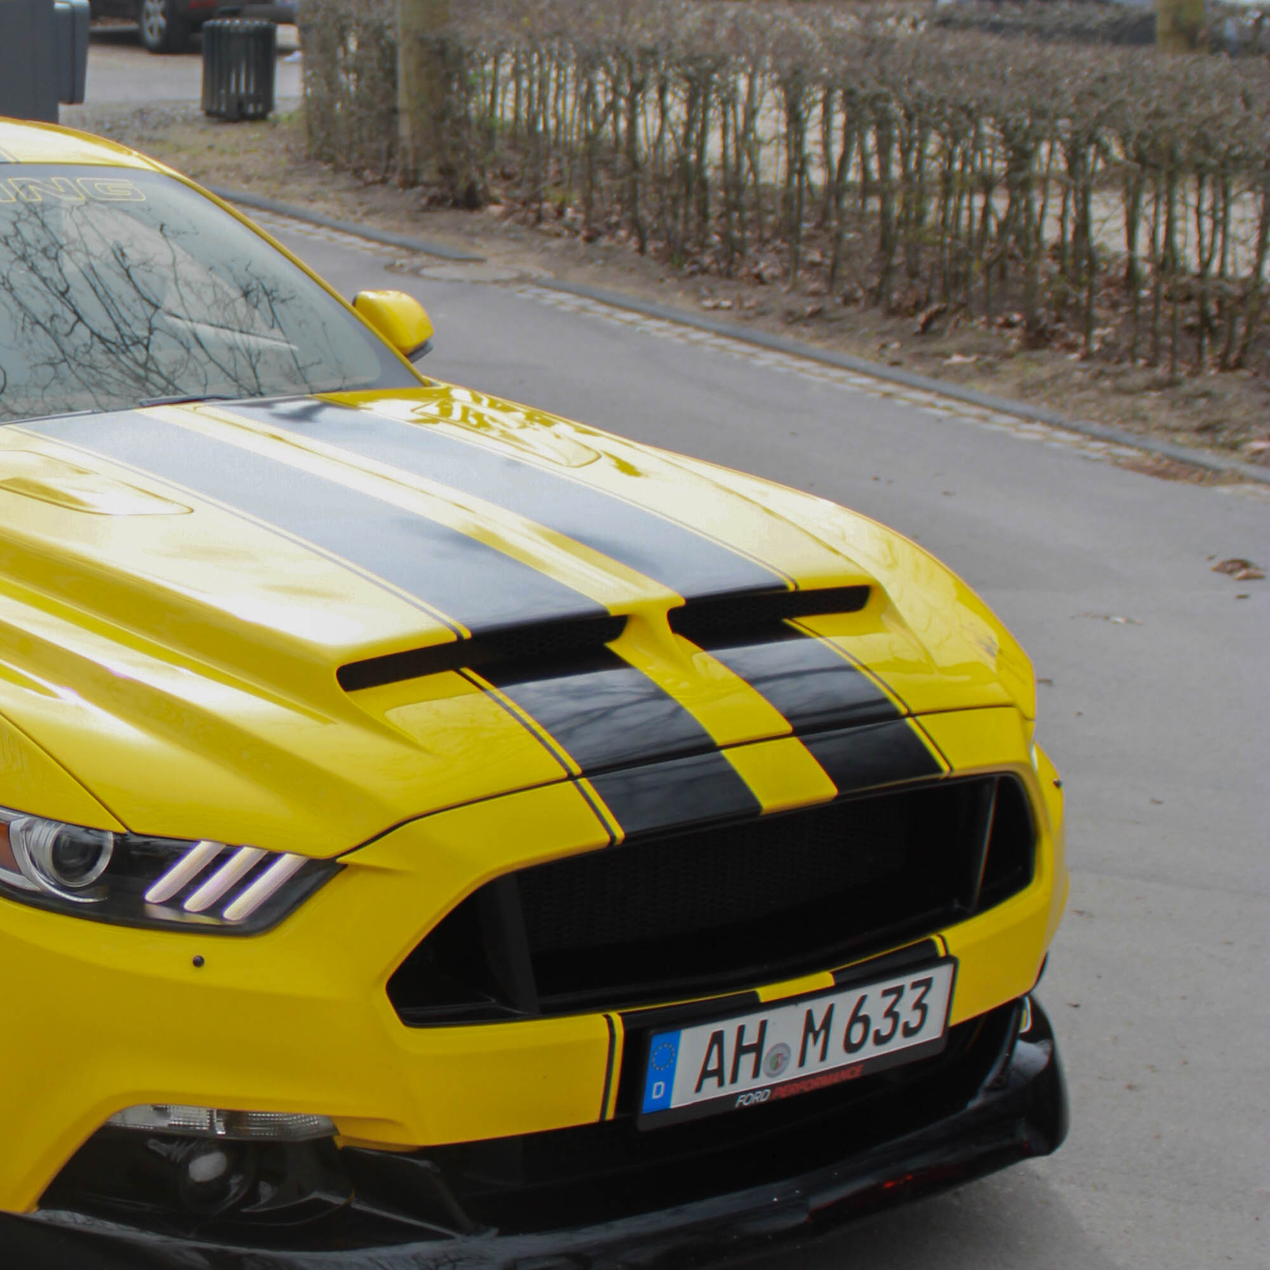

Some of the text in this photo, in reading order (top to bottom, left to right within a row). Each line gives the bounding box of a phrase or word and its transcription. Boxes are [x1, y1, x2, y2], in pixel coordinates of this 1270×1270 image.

[694, 976, 934, 1093] AH M 633
[651, 1080, 665, 1099] D
[735, 1088, 771, 1108] FORD
